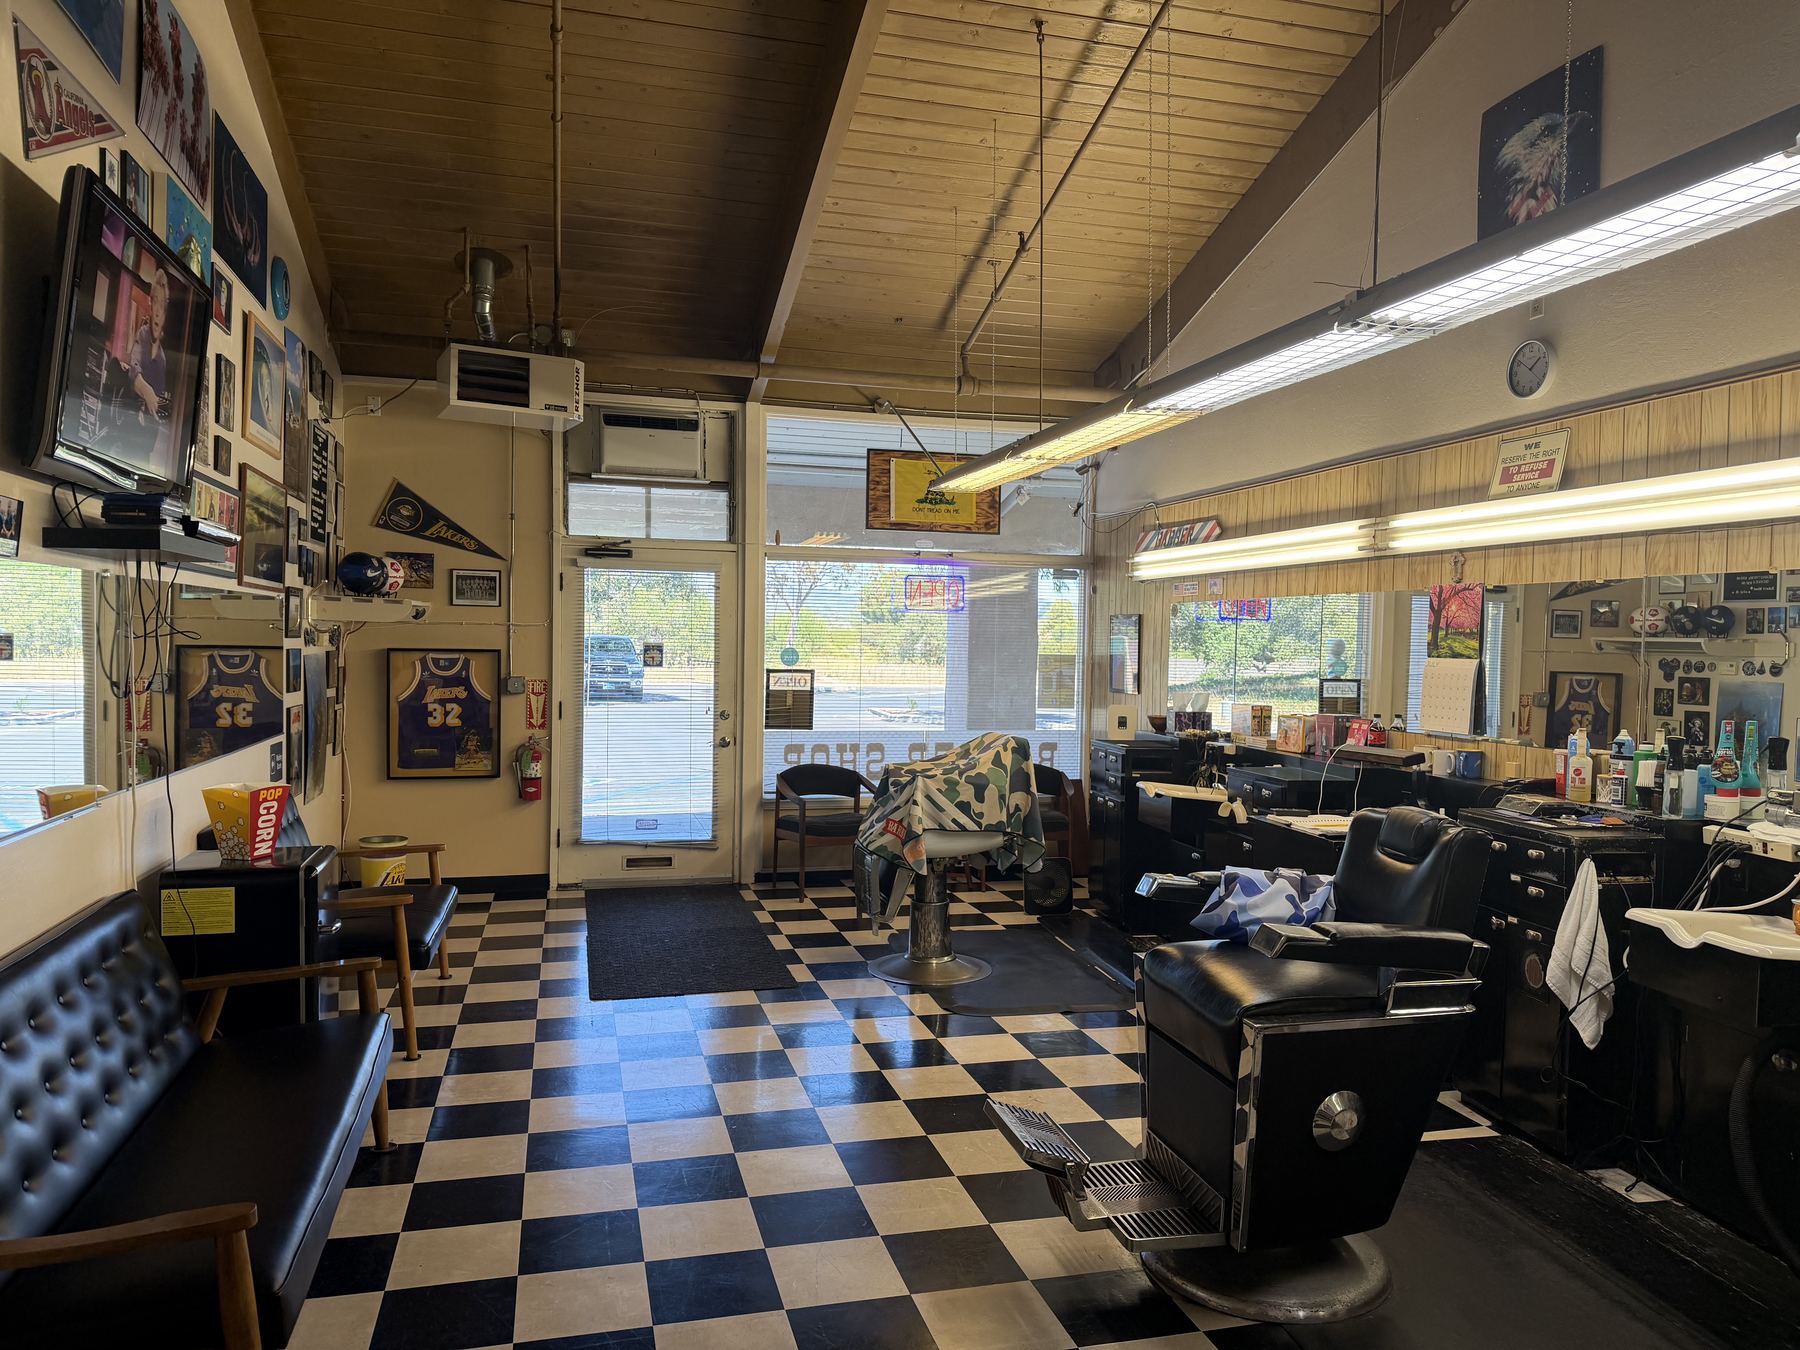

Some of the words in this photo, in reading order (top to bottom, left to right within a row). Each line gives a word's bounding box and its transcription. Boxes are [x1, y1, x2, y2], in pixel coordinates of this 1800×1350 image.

[54, 80, 96, 138] Angels
[1524, 441, 1542, 450] WE
[1501, 454, 1527, 465] RESERVE
[1529, 451, 1540, 460] THE
[1541, 448, 1560, 457] RIGHT
[1520, 461, 1548, 472] REFUSE
[1513, 471, 1540, 482] SERVICE
[1507, 485, 1514, 493] TO
[1516, 482, 1540, 491] ANYONE
[927, 506, 942, 514] TREAD
[420, 519, 479, 551] LAKERS
[1154, 524, 1195, 548] BARBER
[529, 681, 546, 693] FIRE
[427, 702, 463, 728] 32
[259, 787, 283, 802] POP
[253, 800, 278, 857] CORN
